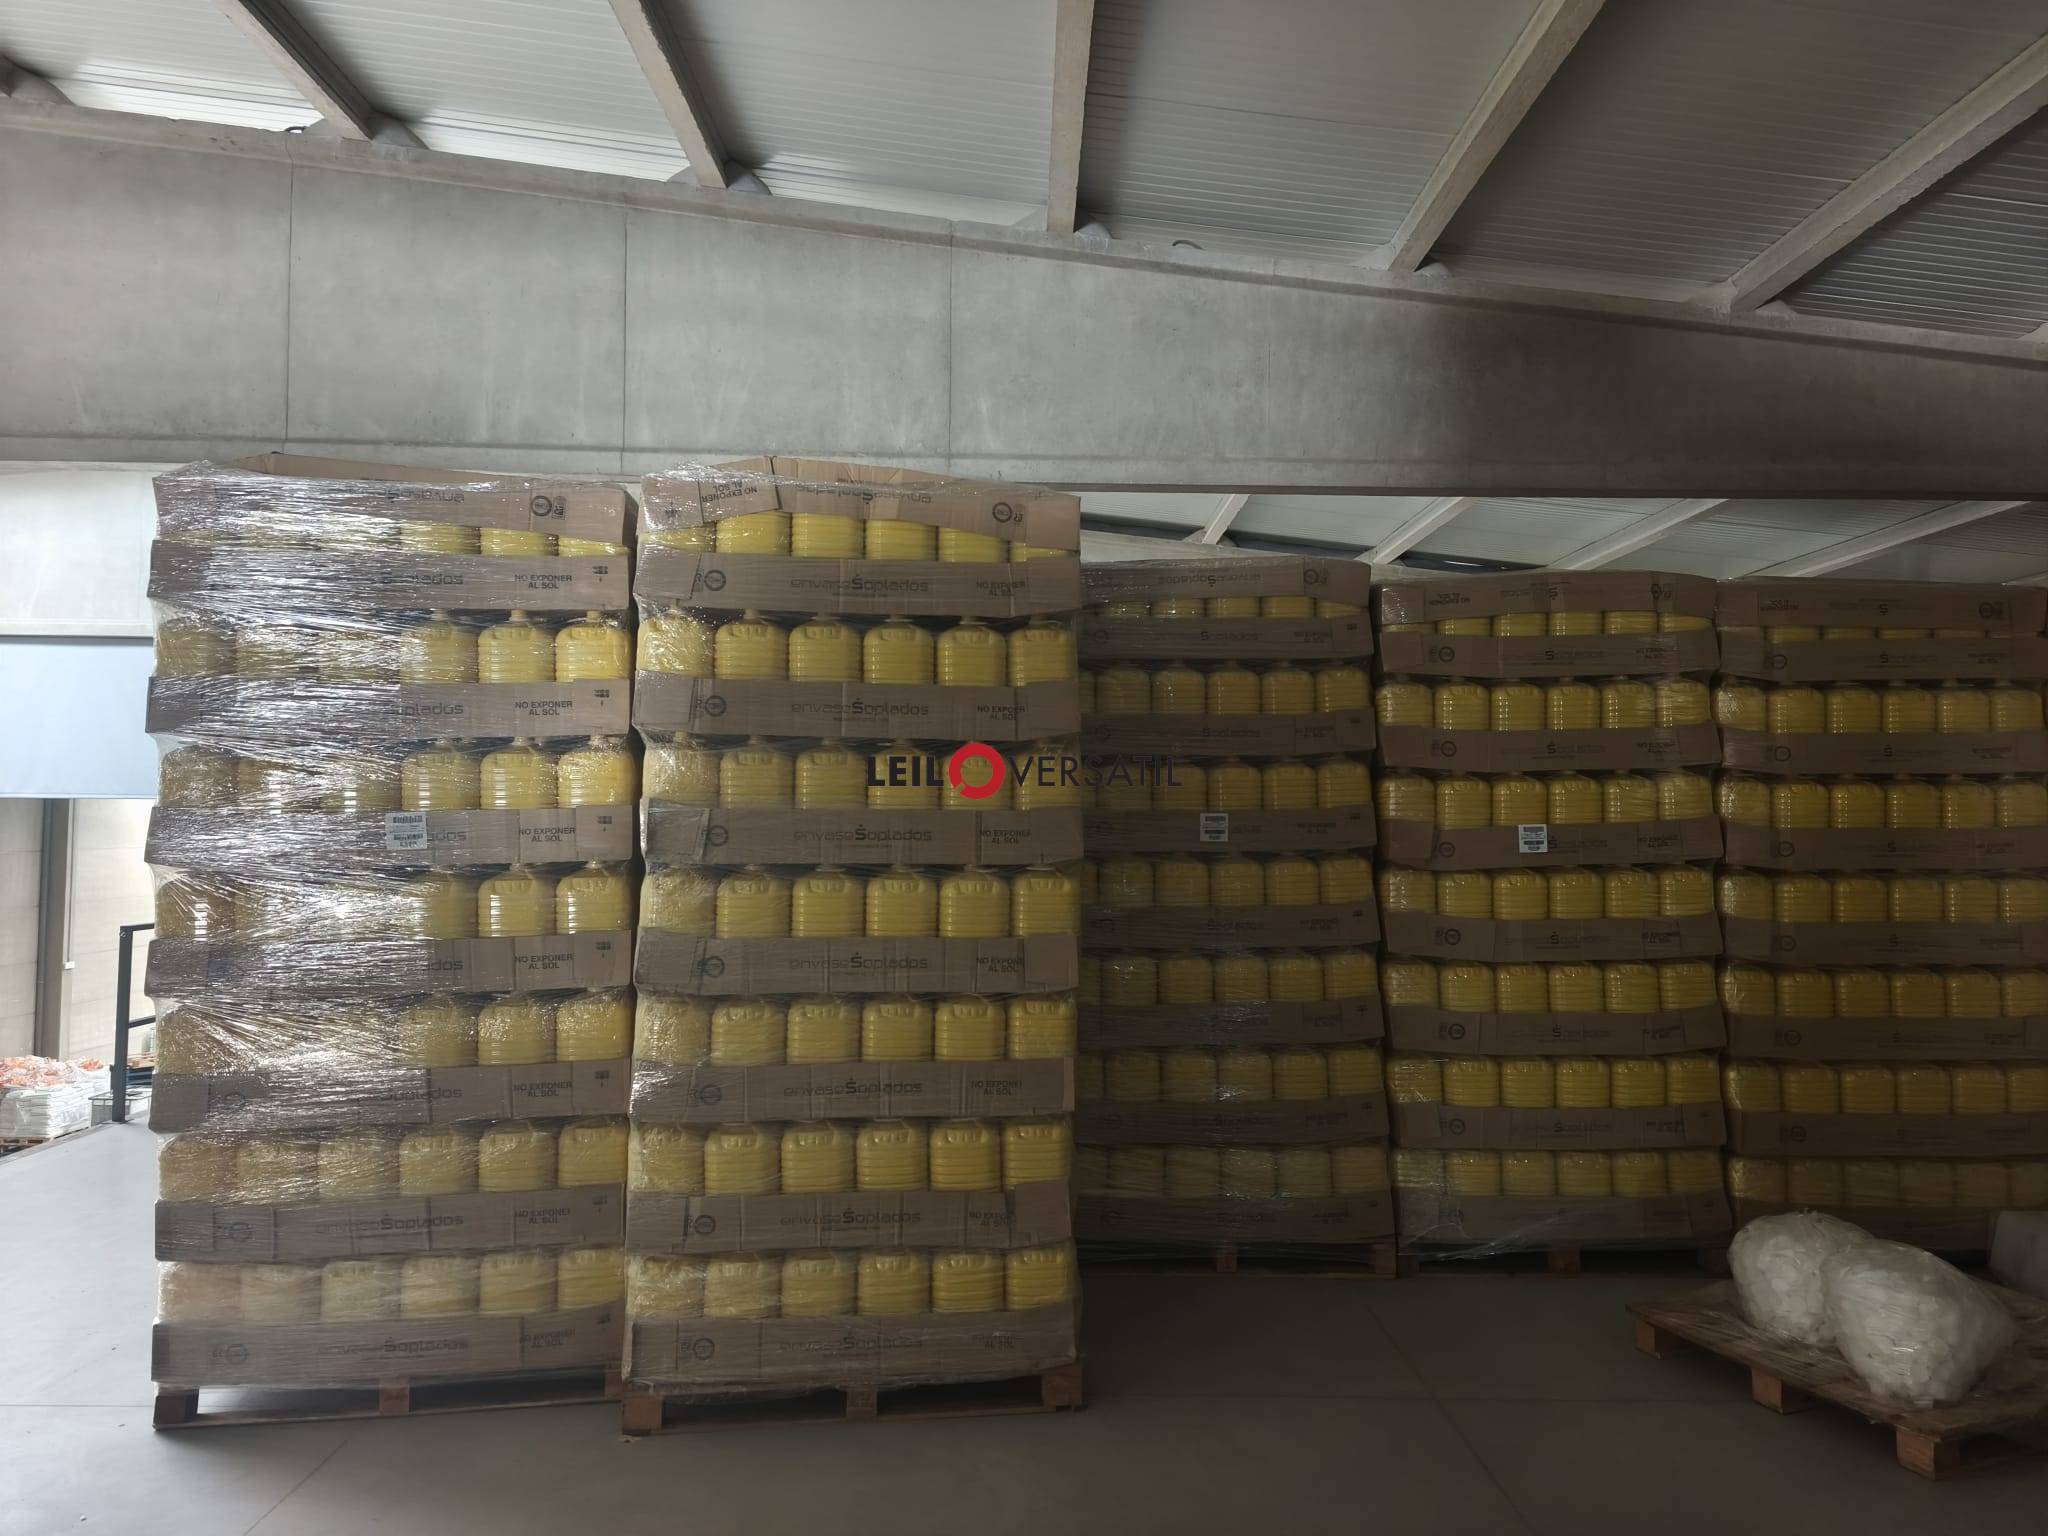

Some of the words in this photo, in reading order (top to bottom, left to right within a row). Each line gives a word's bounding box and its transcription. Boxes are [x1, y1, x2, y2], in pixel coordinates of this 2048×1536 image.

[514, 574, 528, 582] NO
[529, 574, 573, 582] EXPONER
[514, 701, 528, 709] NO
[530, 700, 573, 709] EXPONER
[534, 827, 576, 835] EXPONER
